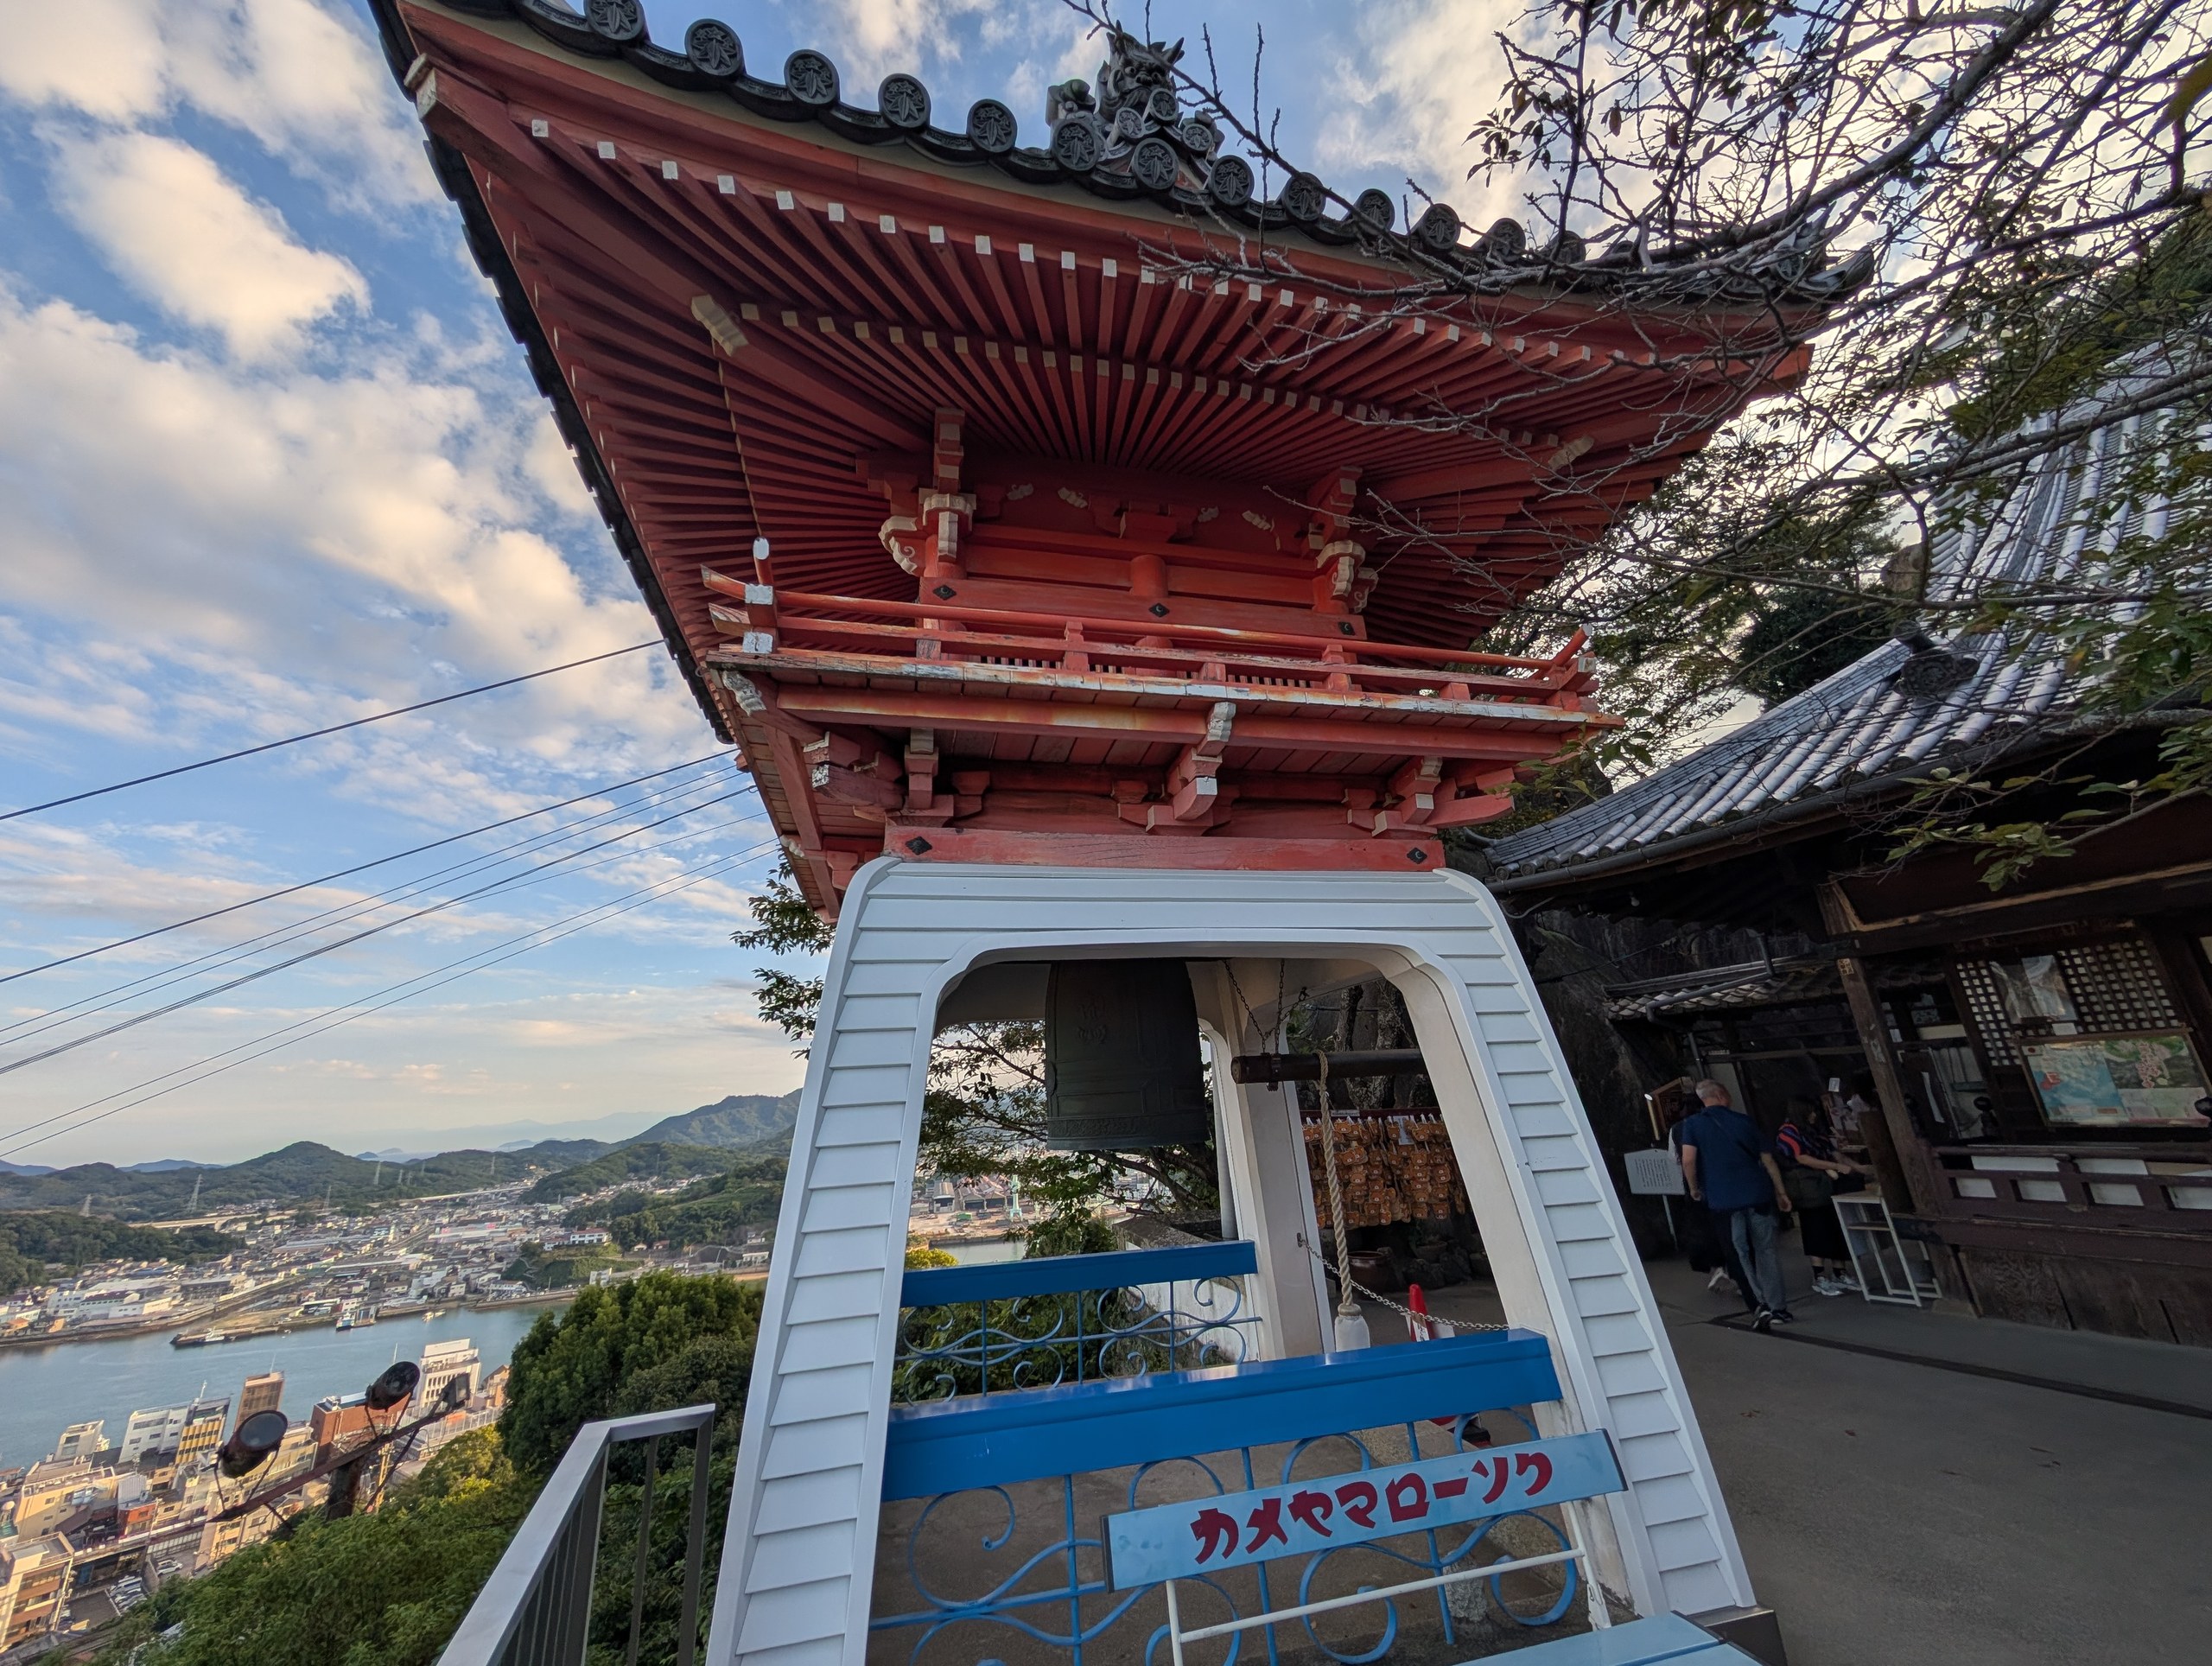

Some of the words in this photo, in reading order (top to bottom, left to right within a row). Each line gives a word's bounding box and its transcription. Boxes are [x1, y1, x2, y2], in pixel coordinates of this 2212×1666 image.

[1190, 1453, 1553, 1565] カメヤマローソク
